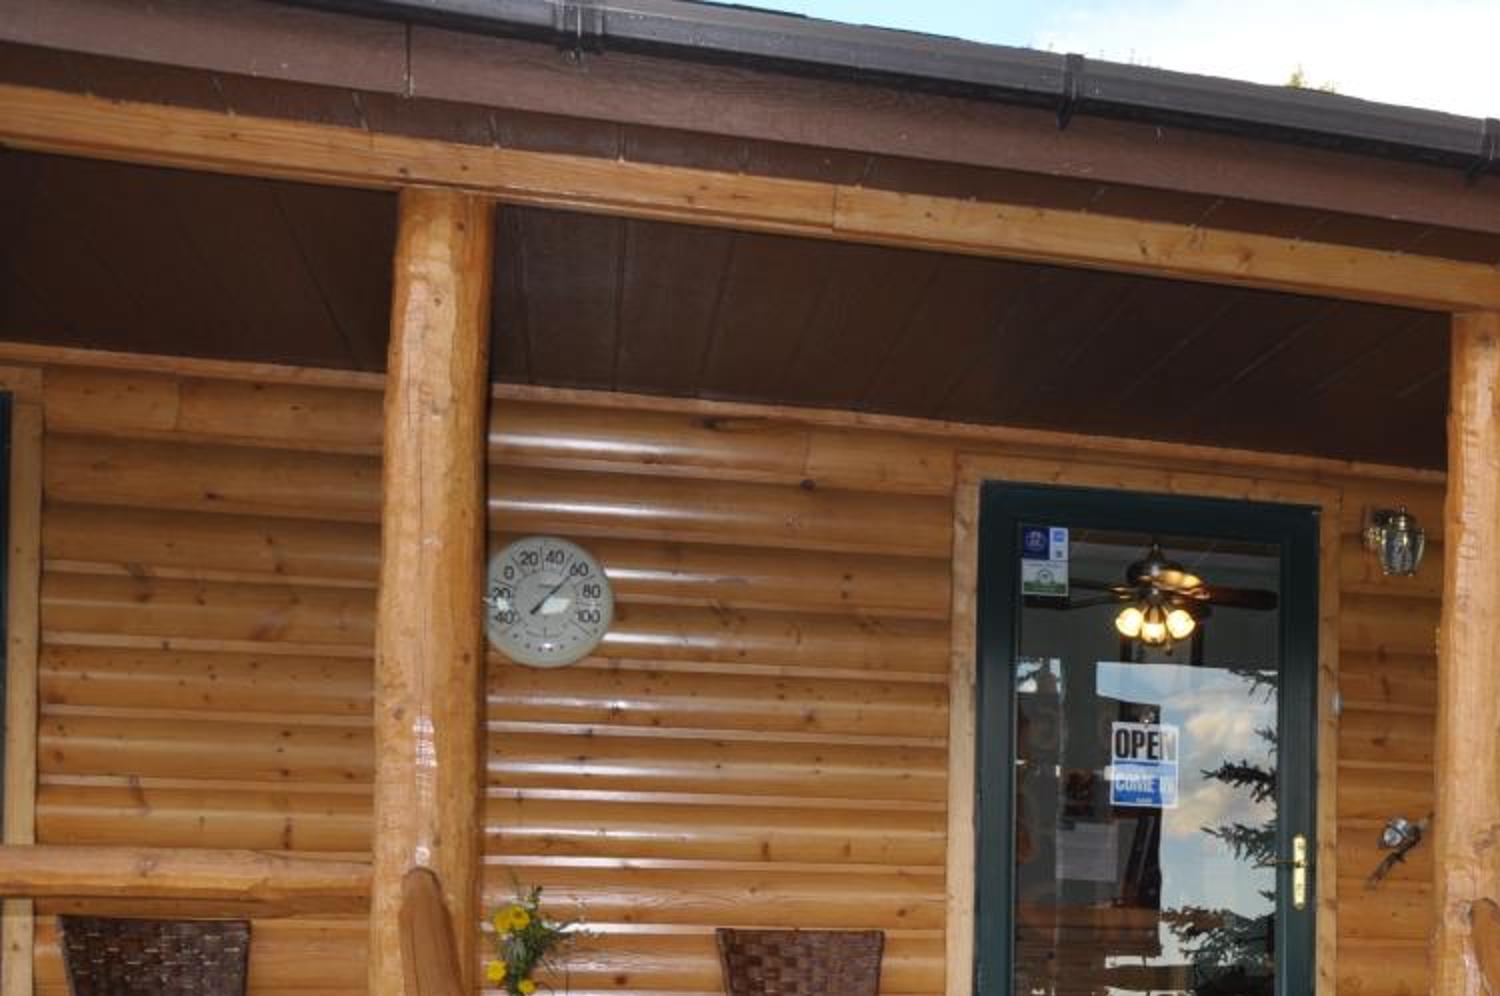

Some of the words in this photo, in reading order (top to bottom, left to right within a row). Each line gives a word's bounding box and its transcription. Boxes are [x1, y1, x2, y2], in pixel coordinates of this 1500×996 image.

[519, 550, 539, 566] 20
[545, 550, 565, 565] 40
[569, 561, 589, 577] 60
[582, 583, 601, 599] 80
